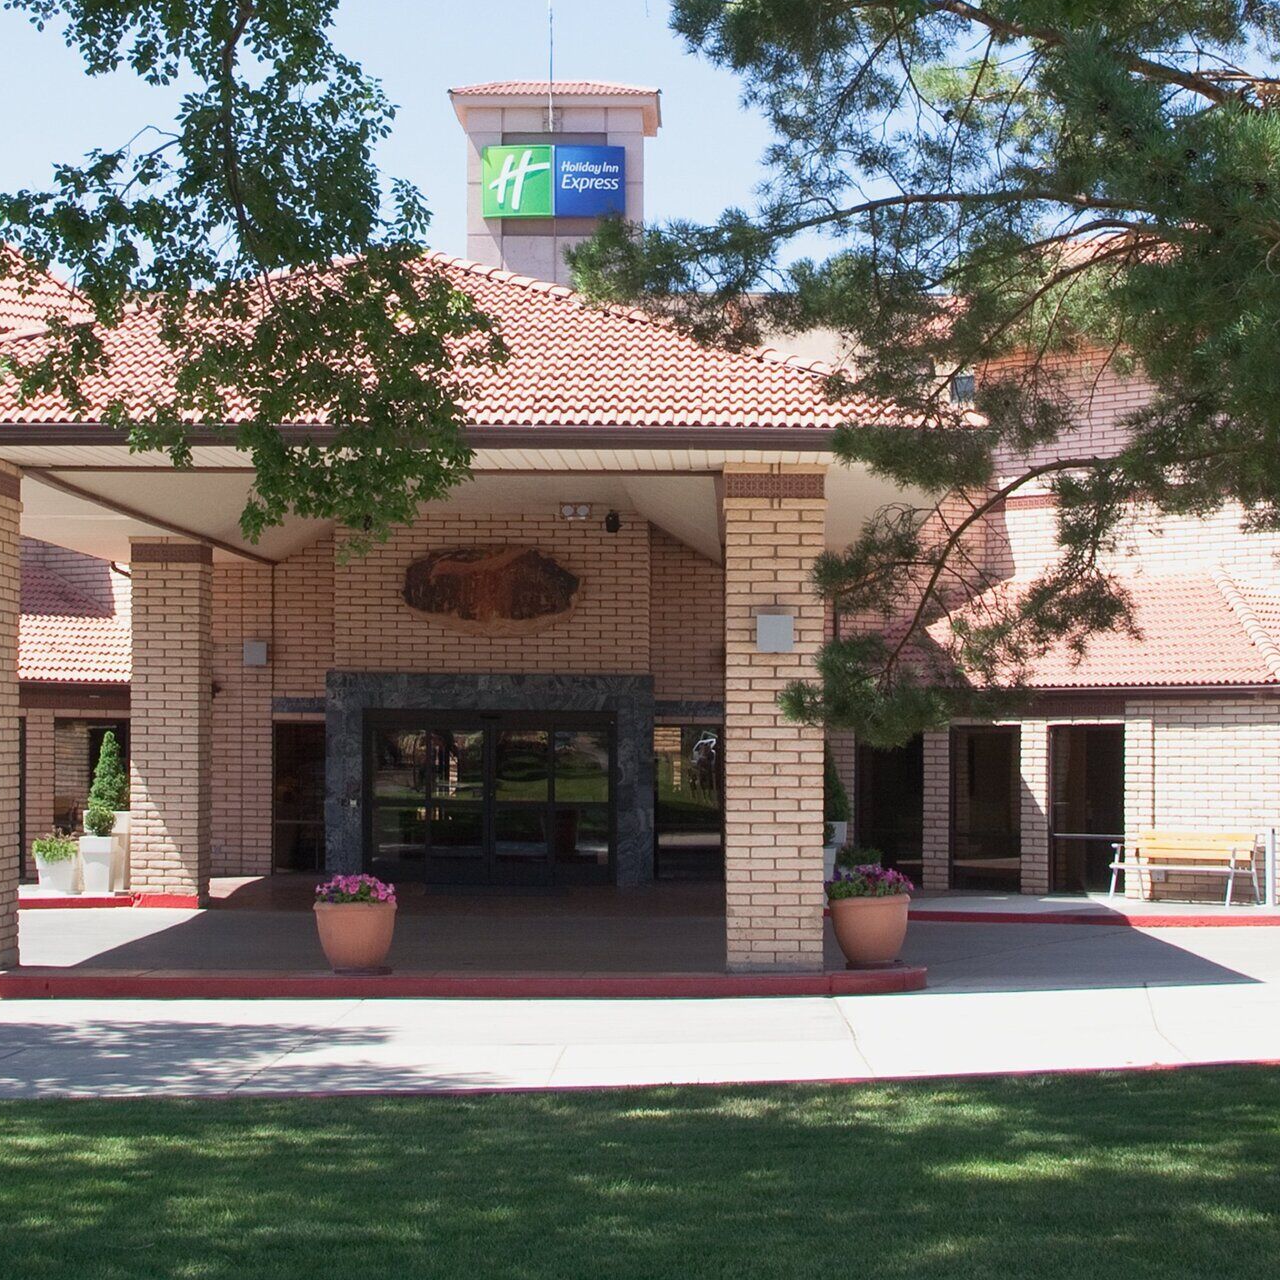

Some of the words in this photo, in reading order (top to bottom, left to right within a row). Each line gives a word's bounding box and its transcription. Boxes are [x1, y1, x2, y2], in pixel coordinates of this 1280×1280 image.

[561, 161, 601, 175] Holiday
[602, 162, 619, 173] Inn
[561, 174, 619, 193] Express
